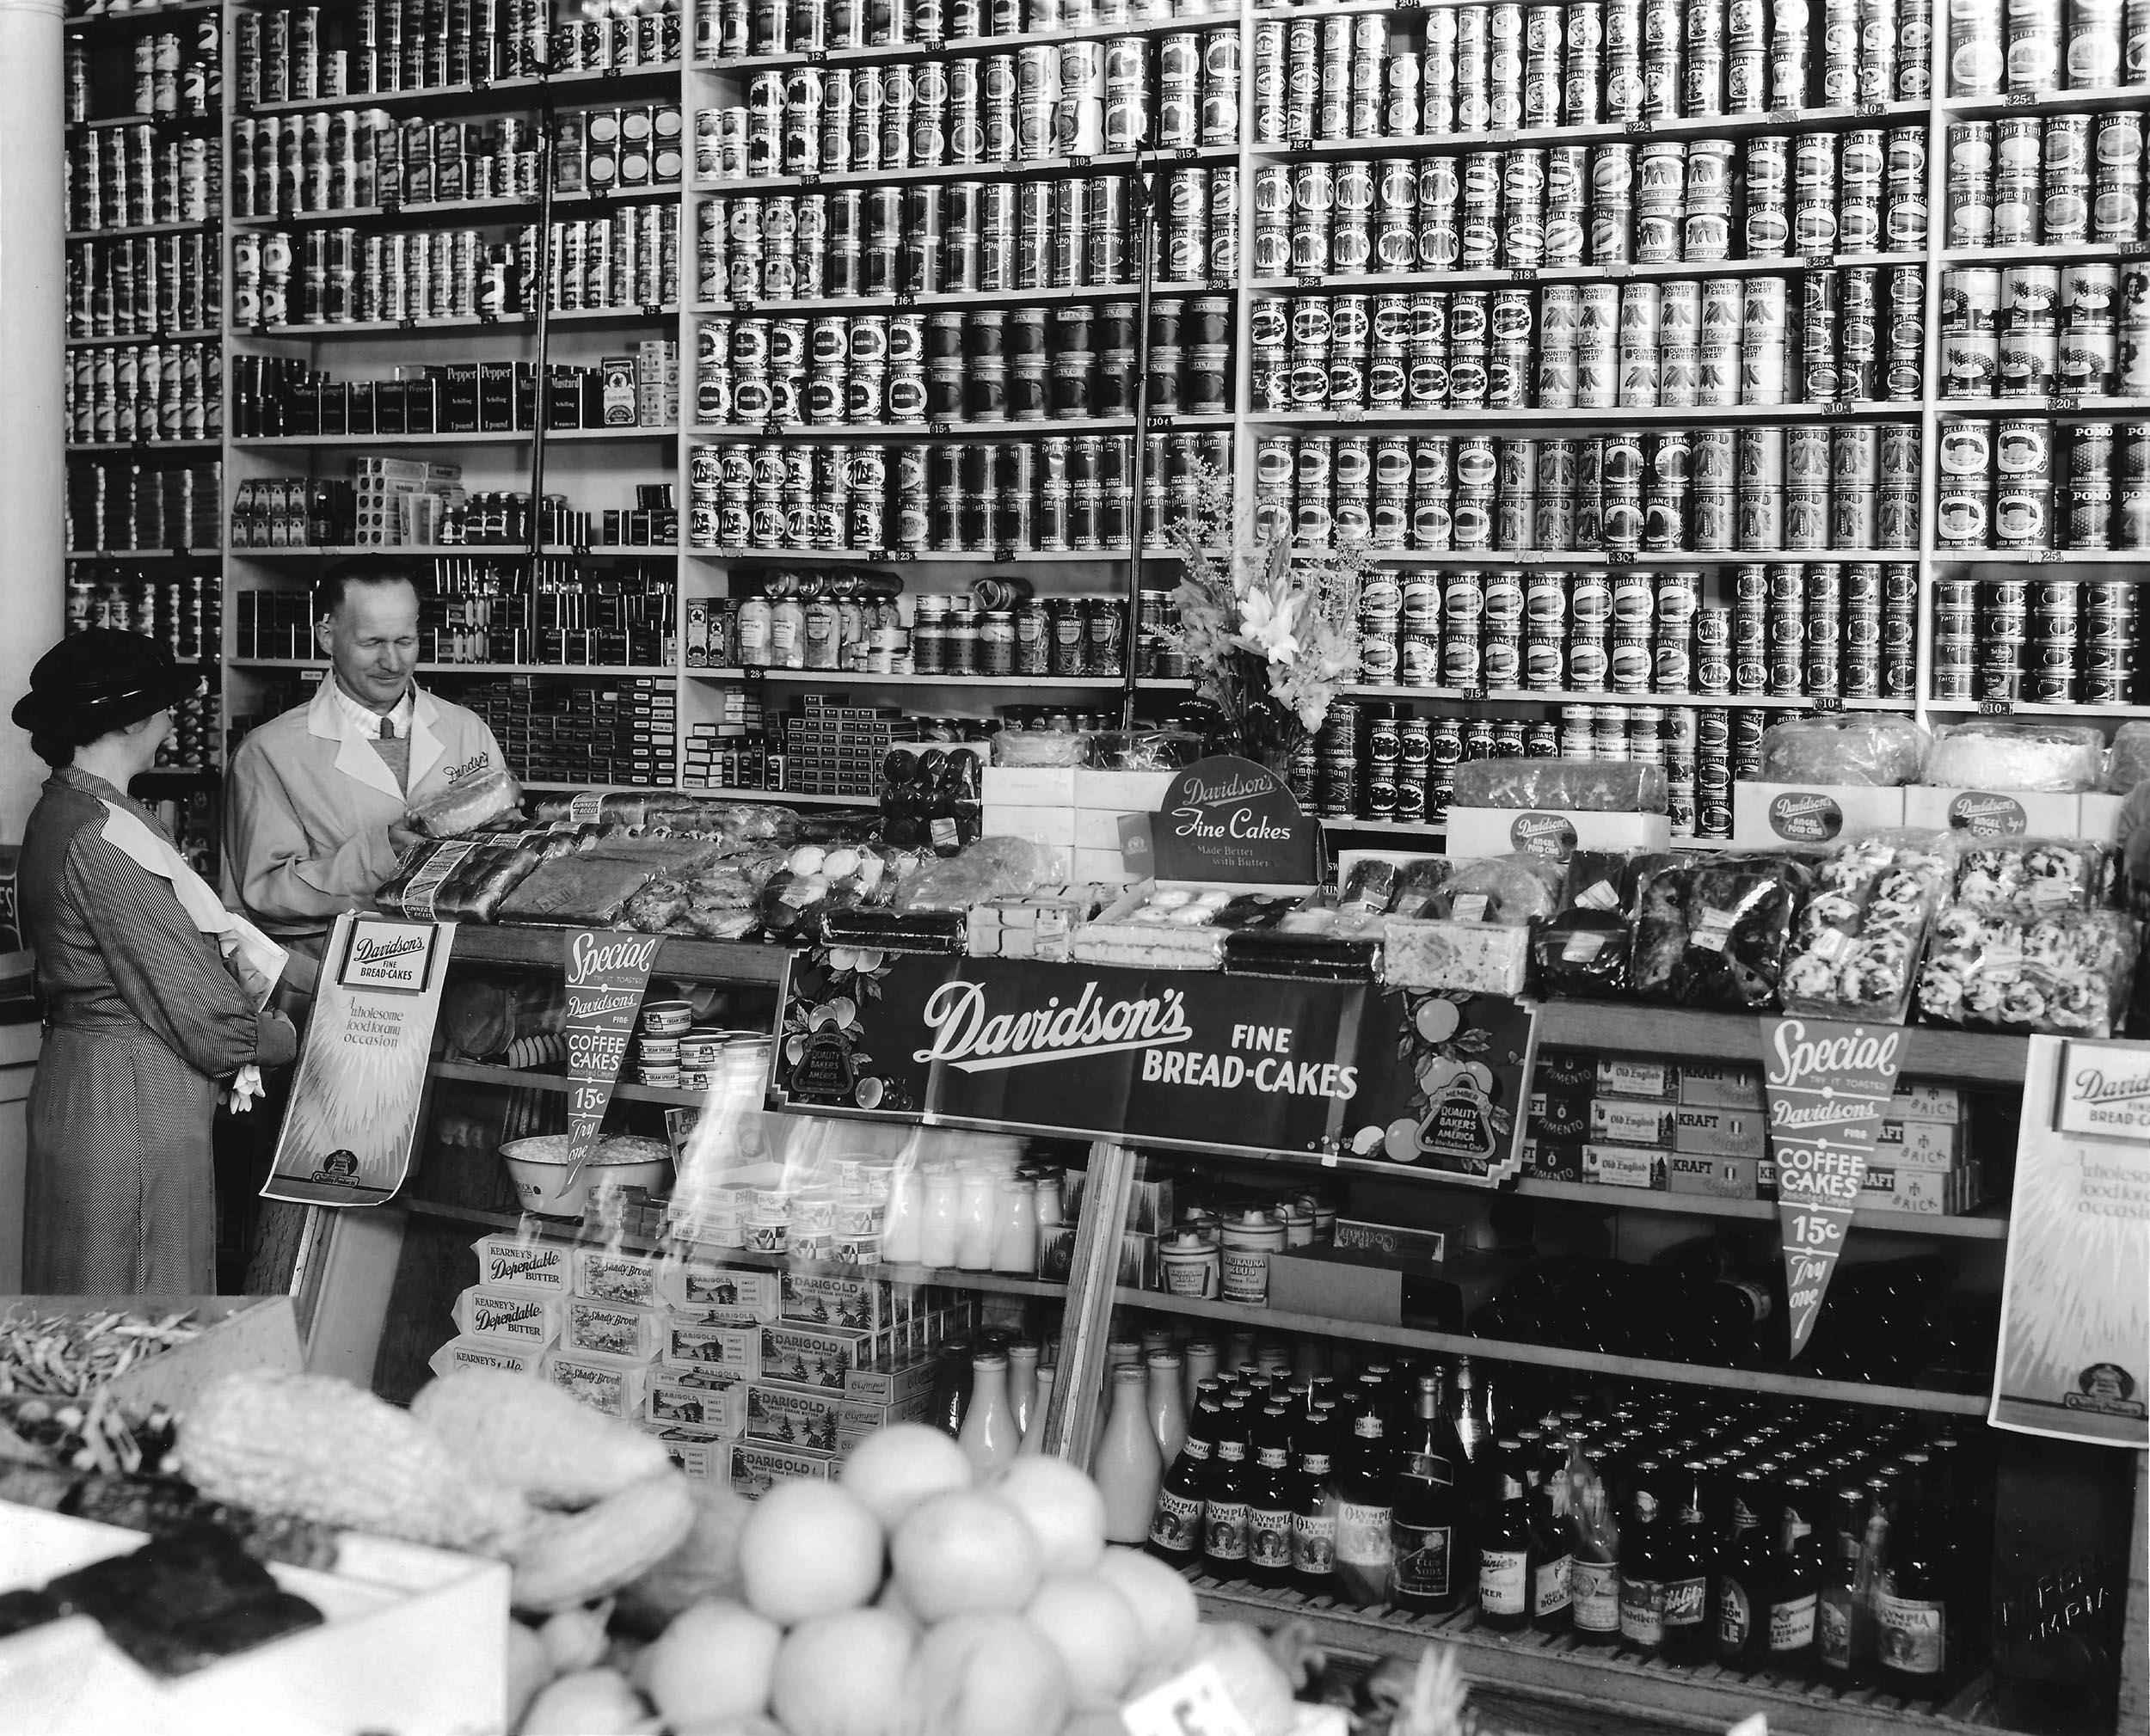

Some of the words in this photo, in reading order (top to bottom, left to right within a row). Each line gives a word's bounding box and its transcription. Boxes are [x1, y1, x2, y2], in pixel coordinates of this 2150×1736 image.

[447, 367, 476, 381] Pepper
[482, 365, 512, 381] Pepper
[1182, 773, 1277, 807] Davidson's
[1171, 807, 1225, 838] Fine
[1230, 807, 1291, 839] Cakes
[1197, 845, 1221, 855] Made
[1213, 857, 1235, 867] with
[353, 935, 425, 964] Davidson's
[568, 933, 655, 984] Special
[360, 967, 413, 981] BREAD-CAKES
[912, 979, 1193, 1074] Davidson's
[344, 1033, 398, 1048] occasion
[568, 1034, 625, 1054] COFFEE
[1231, 1024, 1292, 1053] FINE
[570, 1052, 620, 1071] CAKES
[1769, 1020, 1899, 1086] Special
[1142, 1048, 1359, 1100] BREAD-CAKES
[1545, 1067, 1591, 1085] PIMENTO
[1846, 1078, 1888, 1092] TOASTED
[1441, 1107, 1478, 1119] QUALITY
[1909, 1098, 1957, 1117] BRICK
[1440, 1117, 1477, 1130] BAKERS
[1538, 1117, 1584, 1135] PIMENTO
[1678, 1113, 1719, 1128] KRAFT
[571, 1119, 594, 1144] Try
[1437, 1129, 1475, 1142] AMERICA
[1844, 1128, 1868, 1140] FINE
[568, 1144, 589, 1162] one
[1901, 1146, 1947, 1163] BRICK
[1617, 1161, 1647, 1172] English
[1673, 1159, 1713, 1174] KRAFT
[1777, 1148, 1866, 1176] COFFEE
[1530, 1164, 1575, 1181] PIMENTO
[1781, 1169, 1858, 1199] CAKES
[1892, 1193, 1938, 1212] BRICK
[490, 1247, 531, 1260] KEARNEY'S
[490, 1250, 561, 1280] Dependable
[629, 1265, 653, 1277] Brook
[1230, 1267, 1256, 1277] KLUB
[1790, 1254, 1828, 1287] Try
[525, 1273, 560, 1284] BUTTER
[796, 1275, 858, 1294] DARIGOLD
[475, 1298, 515, 1311] KEARNEY'S
[1789, 1288, 1820, 1309] one
[475, 1303, 542, 1332] Dependable
[589, 1310, 615, 1326] Shady
[614, 1314, 637, 1327] Brook
[508, 1323, 541, 1336] BUTTER
[677, 1332, 717, 1341] DARIGOLD
[776, 1334, 838, 1353] DARIGOLD
[455, 1349, 496, 1366] KEARNEY'S
[573, 1369, 598, 1383] Shady
[597, 1372, 620, 1385] Brook
[762, 1394, 826, 1414] DARIGOLD
[747, 1454, 810, 1475] DARIGOLD
[1206, 1500, 1249, 1518] OLYMPIA
[1249, 1509, 1293, 1524] OLYMPIA
